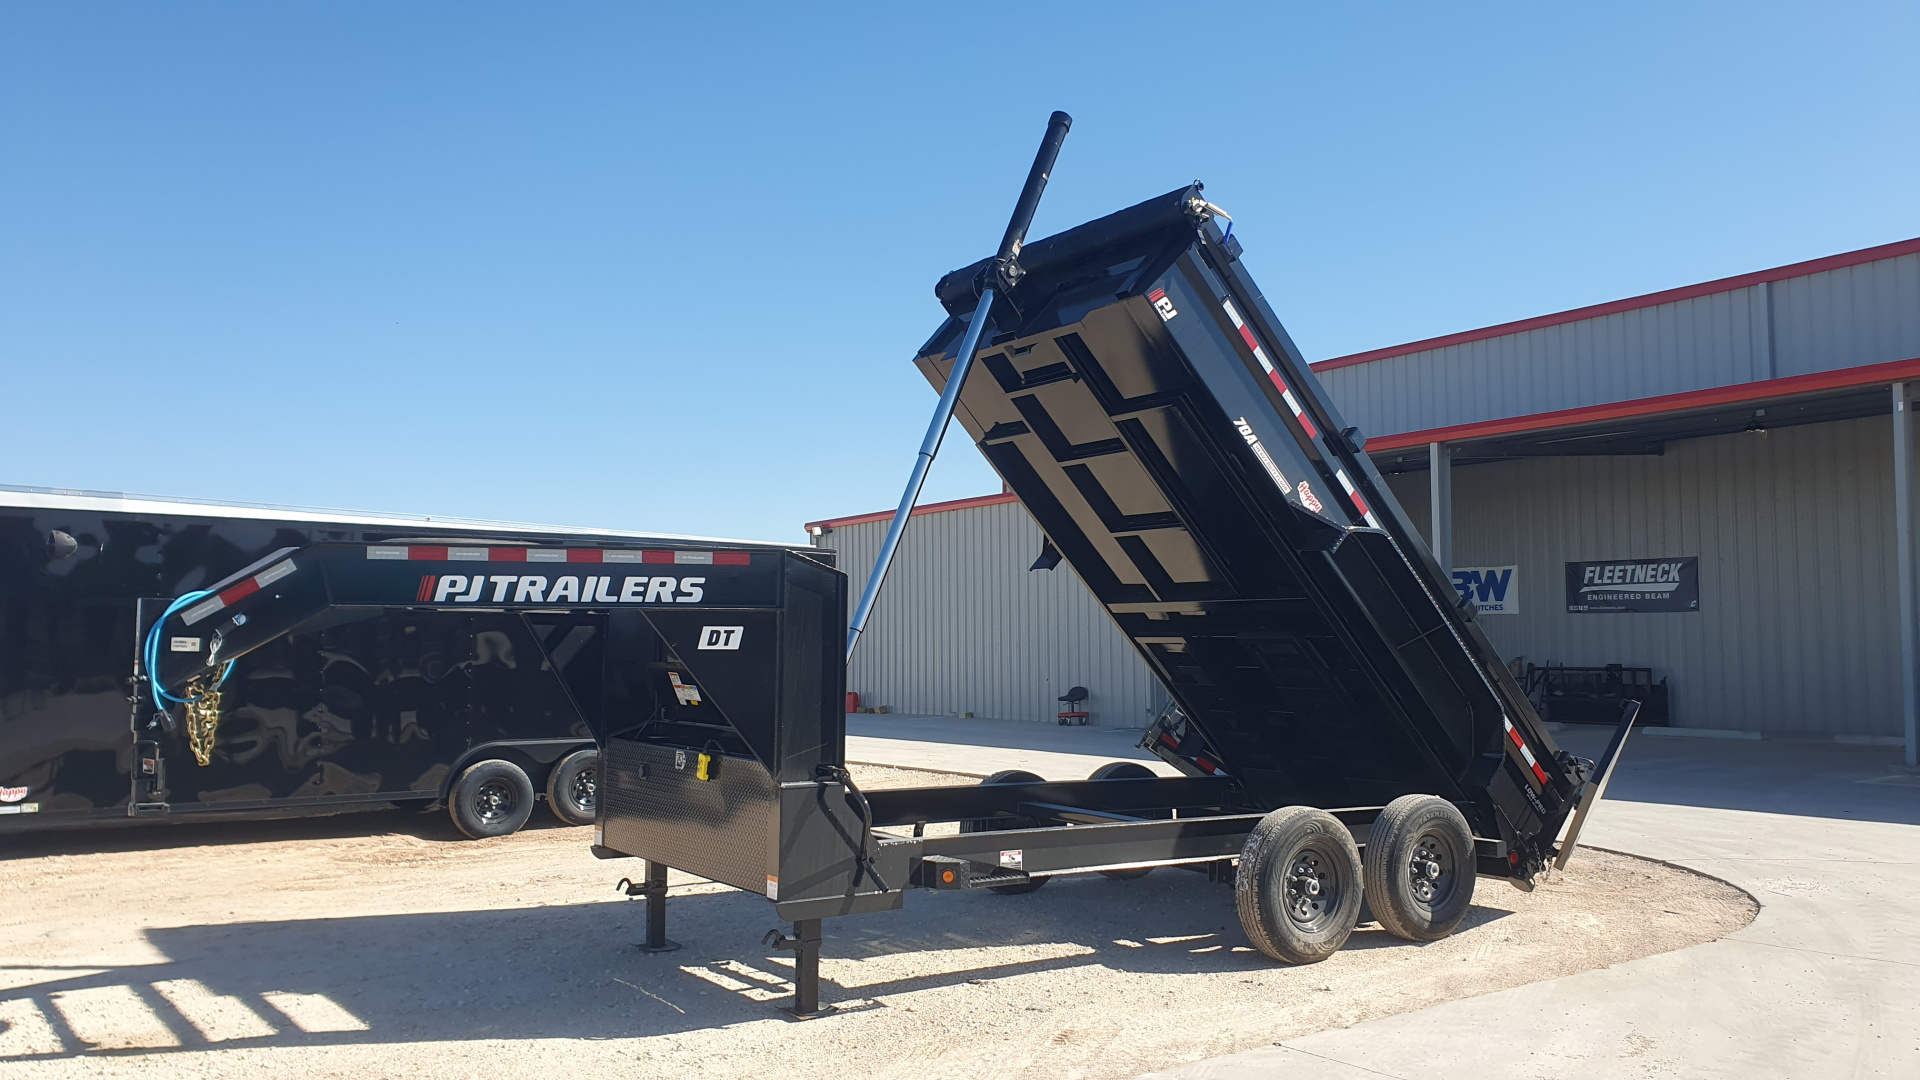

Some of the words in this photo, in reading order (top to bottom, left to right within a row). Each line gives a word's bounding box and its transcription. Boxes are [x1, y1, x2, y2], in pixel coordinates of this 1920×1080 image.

[1156, 296, 1178, 320] PJ
[1233, 416, 1258, 446] 7GA
[1298, 481, 1322, 512] Happy
[1583, 563, 1683, 585] FLEETNECK
[434, 575, 485, 603] PJ
[489, 575, 706, 603] TRAILERS
[1587, 593, 1642, 601] ENGINEERED
[1645, 592, 1670, 600] BEAM
[707, 630, 736, 646] DT
[0, 787, 28, 799] appy
[1524, 784, 1547, 815] LOW-PRO
